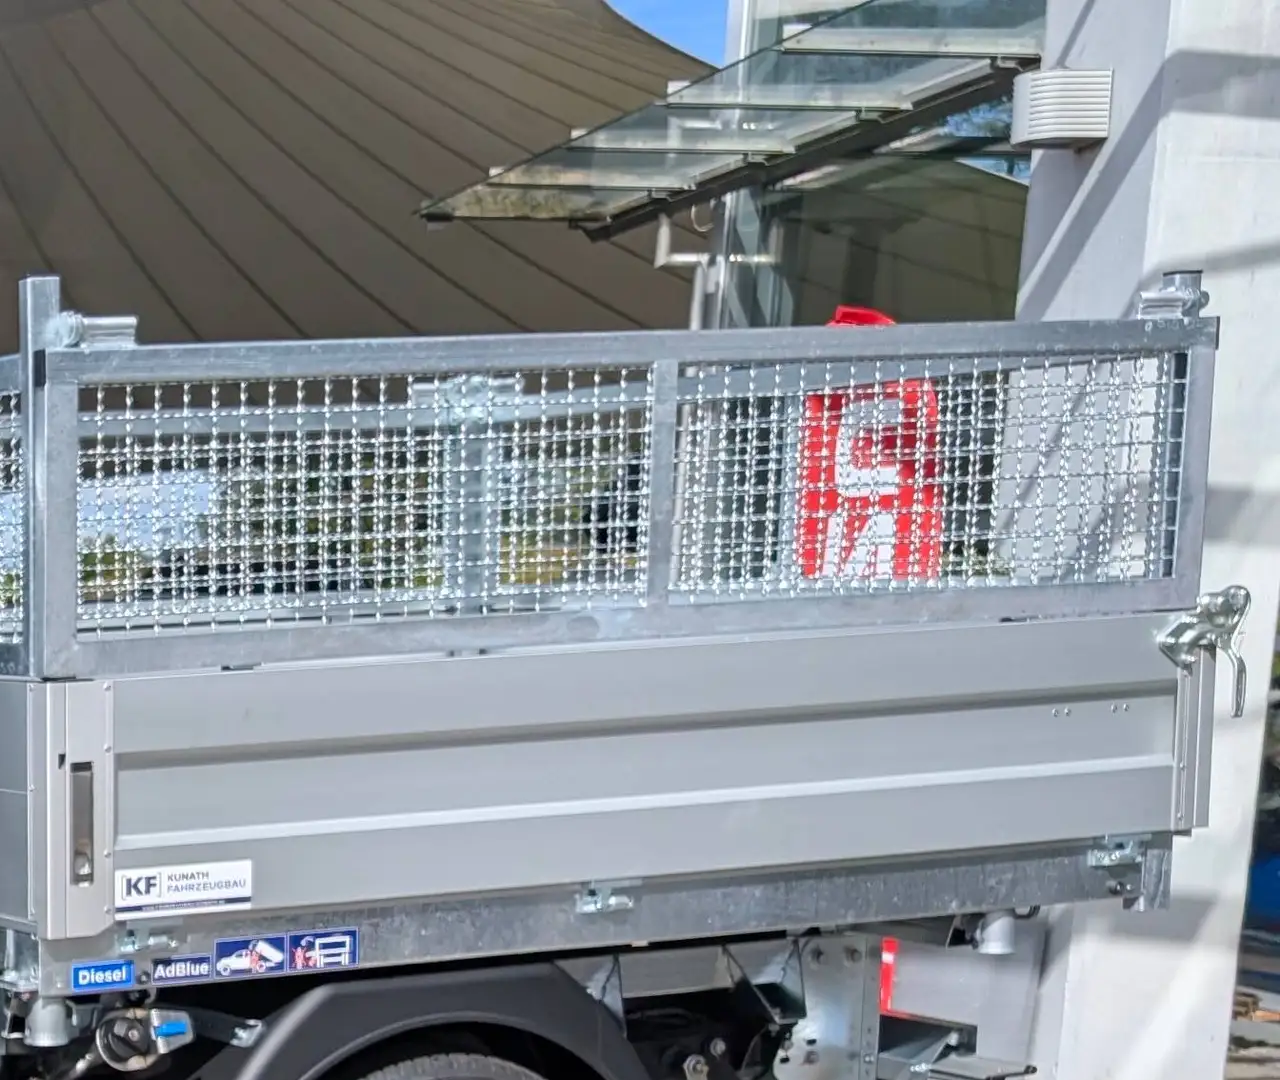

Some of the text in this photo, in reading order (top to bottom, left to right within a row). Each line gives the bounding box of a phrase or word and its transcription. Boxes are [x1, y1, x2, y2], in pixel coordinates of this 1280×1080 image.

[167, 871, 209, 882] KUNATH
[167, 878, 246, 894] FAHRZEUGBAU
[78, 966, 127, 985] Diesel
[154, 961, 209, 979] AdBlue
